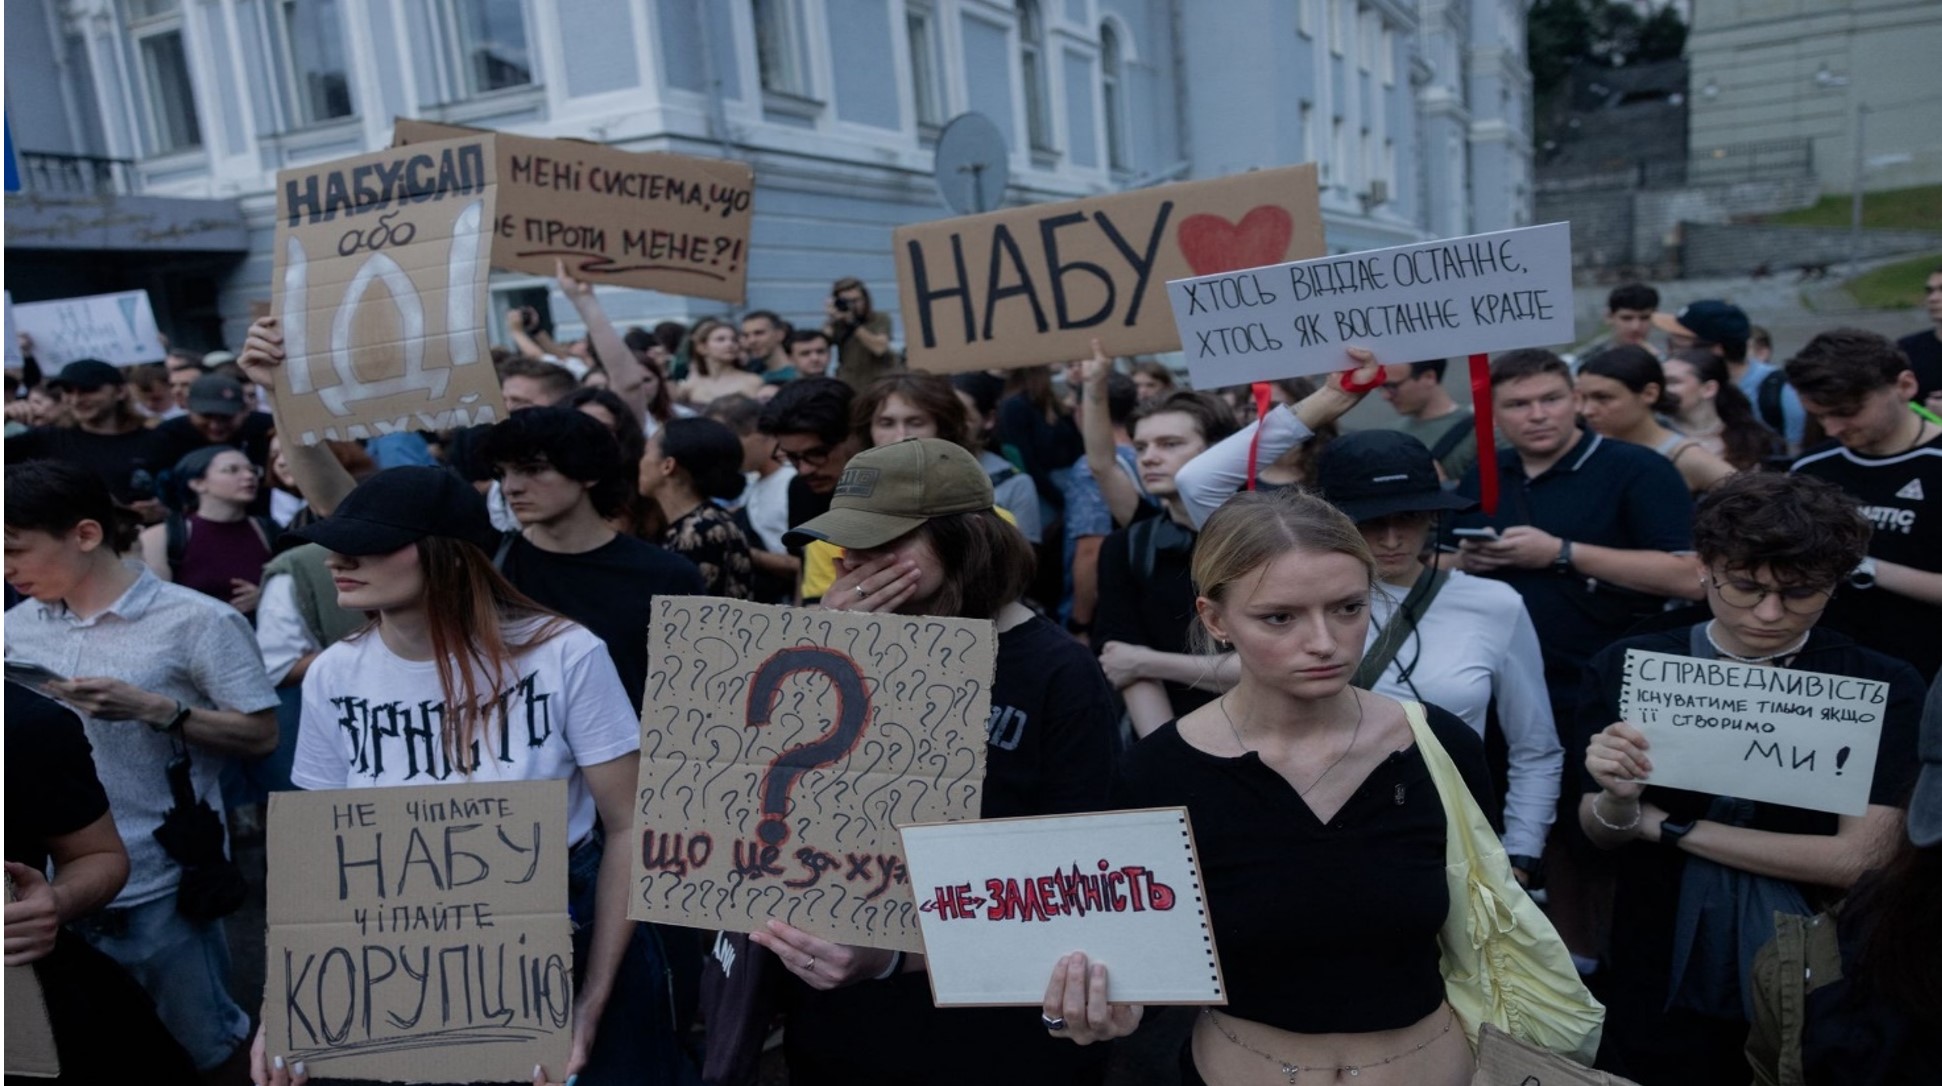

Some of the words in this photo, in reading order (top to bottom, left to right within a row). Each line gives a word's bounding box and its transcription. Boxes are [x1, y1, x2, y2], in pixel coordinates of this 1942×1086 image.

[405, 143, 485, 203] САП
[338, 210, 416, 257] або
[525, 217, 605, 252] ПРОТИ
[623, 228, 742, 272] МЕНЕ?!
[908, 200, 1174, 349] НАБУ
[1183, 274, 1277, 316] ХТОСЬ
[1290, 256, 1388, 302] ВІДДАЄ
[1393, 239, 1528, 288] ОСТАННЄ,
[1196, 322, 1283, 359] ХТОСЬ
[1294, 313, 1328, 348] ЯК
[1334, 298, 1460, 342] ВОСТАННЄ
[1471, 289, 1554, 326] КРАДЕ
[1636, 688, 1748, 713] ІСНУВАТИМЕ
[1757, 700, 1813, 719] ТІЛЬКИ
[1820, 707, 1876, 724] ЯКЩО
[1639, 658, 1886, 704] СПРАВЕДЛИВІСТЬ
[1639, 707, 1659, 724] ЇЇ
[1672, 713, 1776, 734] СТВОРИМО
[333, 803, 377, 830] НЕ
[336, 822, 541, 901] НАБУ
